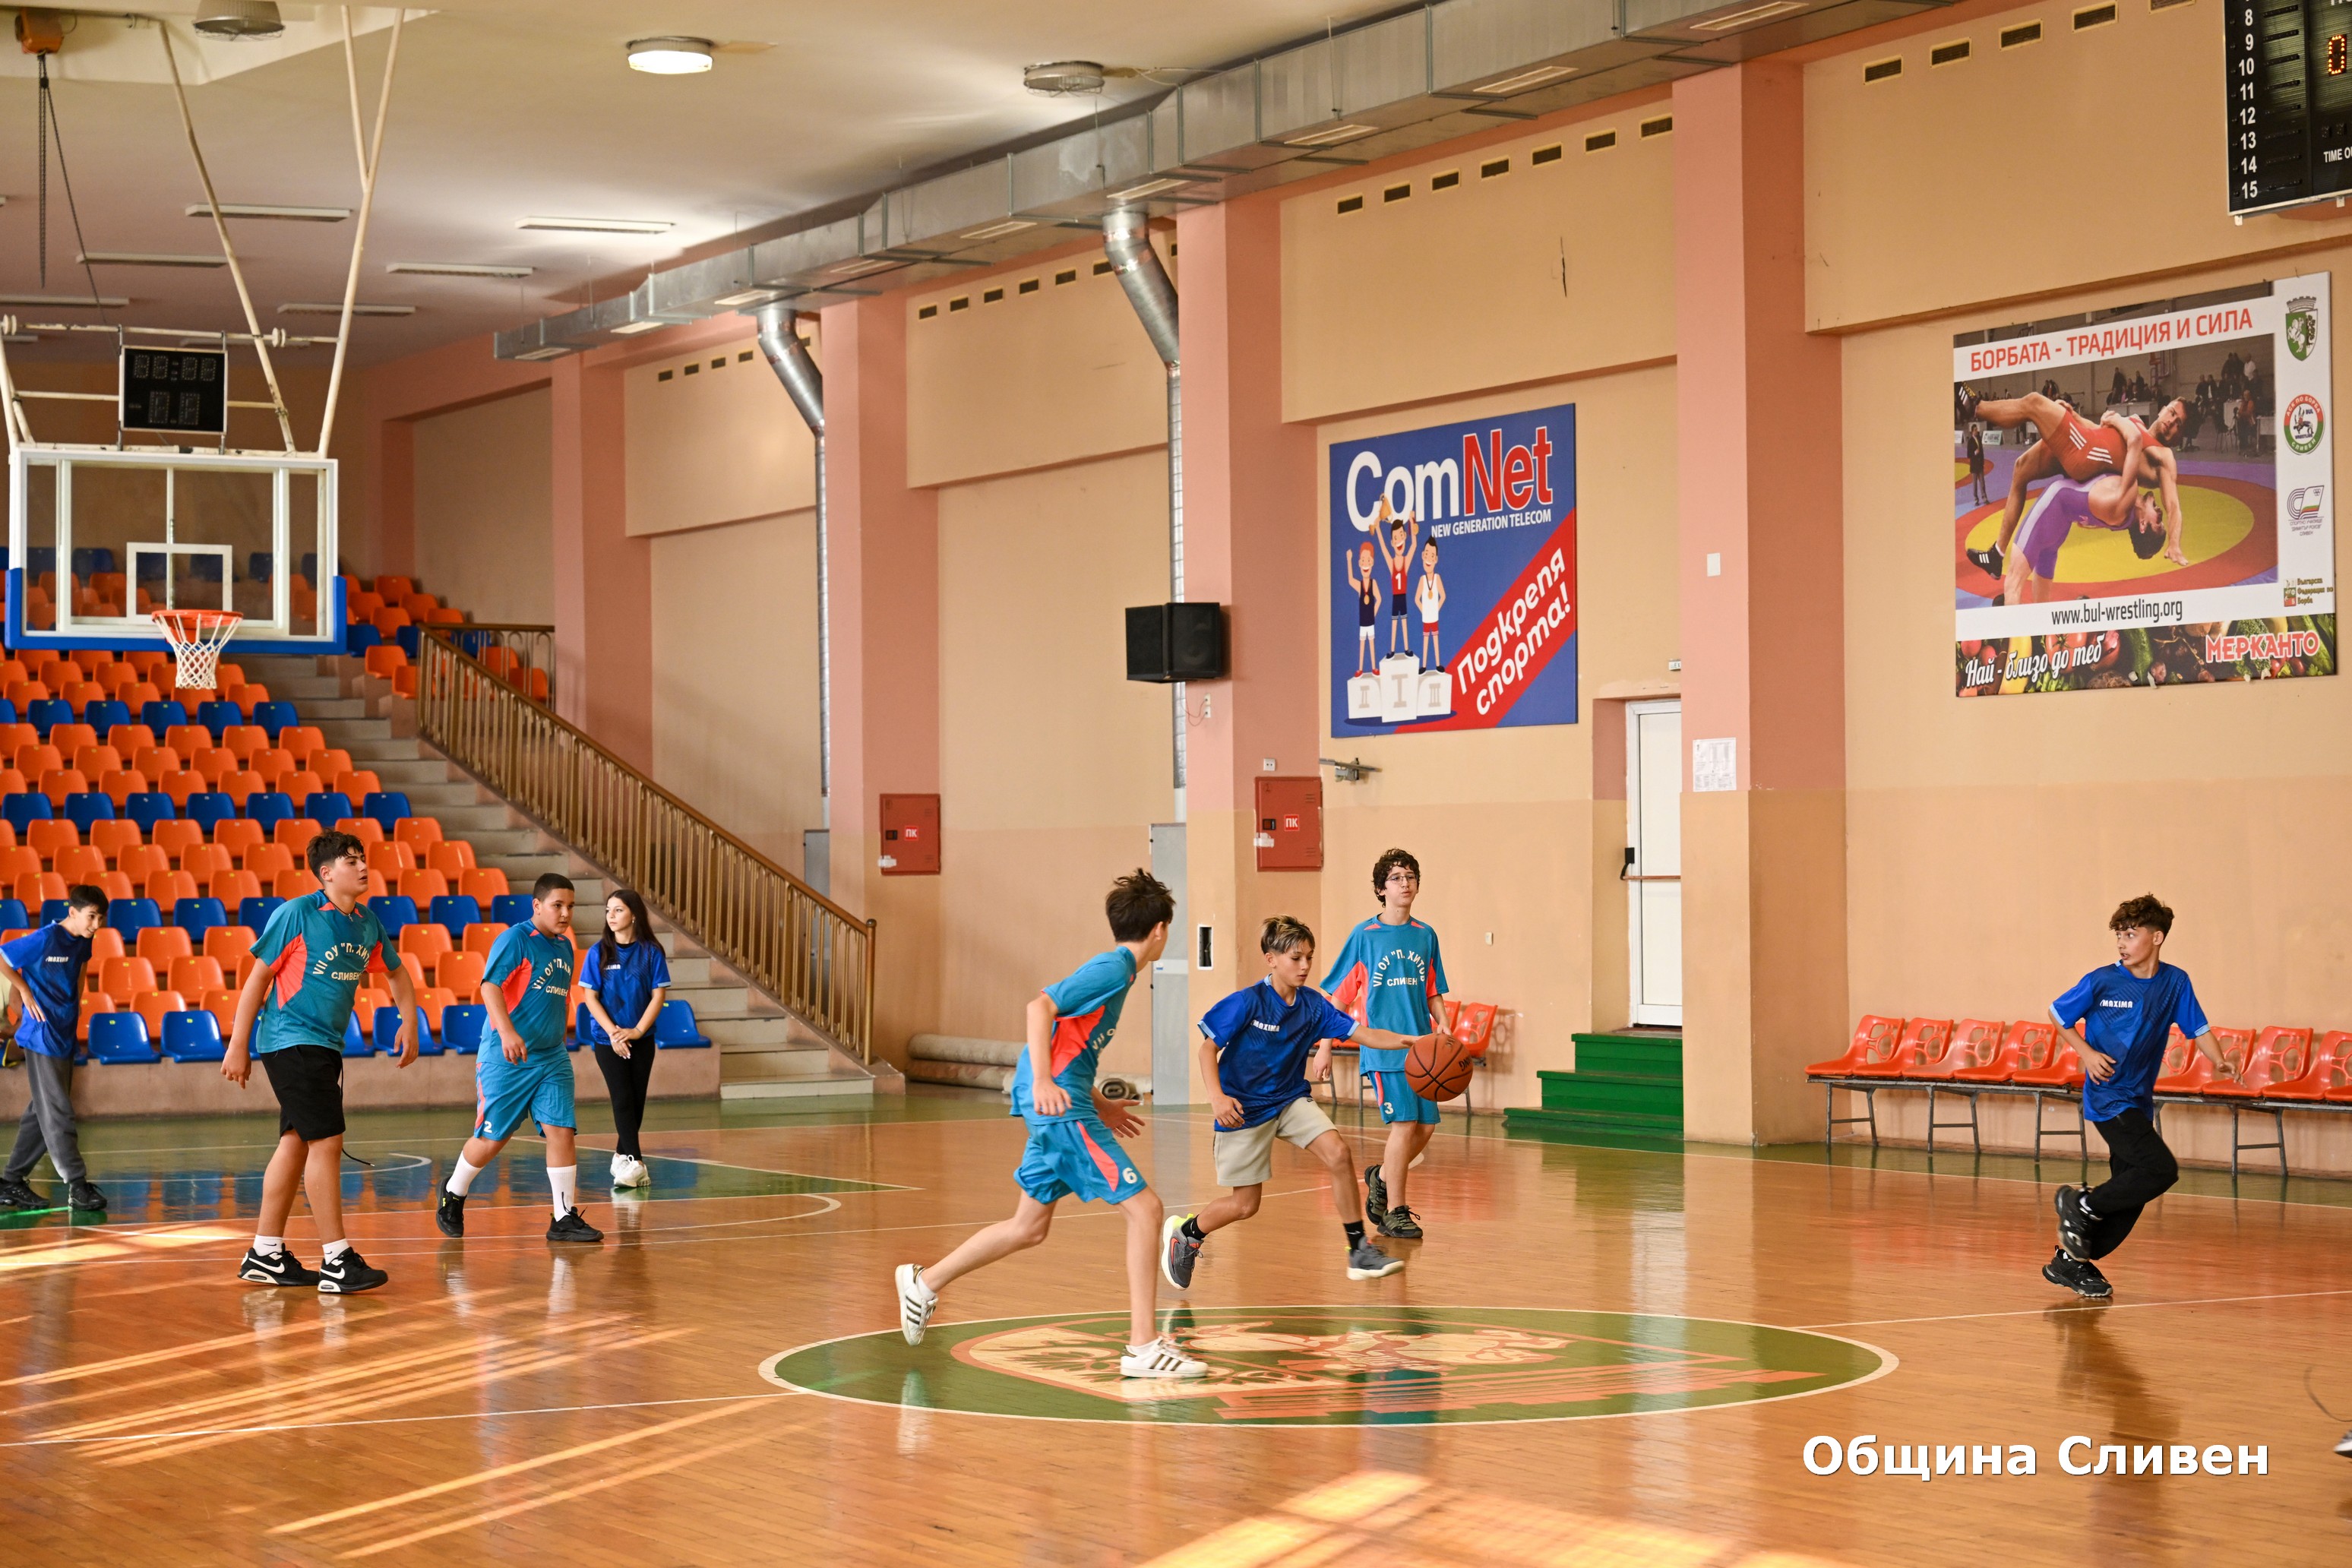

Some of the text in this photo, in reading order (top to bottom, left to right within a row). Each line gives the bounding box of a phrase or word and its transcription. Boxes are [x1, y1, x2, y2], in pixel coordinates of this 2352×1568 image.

[2245, 8, 2253, 27] 8
[2246, 33, 2254, 51] 9
[2328, 34, 2345, 74] 0
[2239, 58, 2255, 76] 10
[2240, 82, 2255, 100] 11
[2240, 106, 2256, 125] 12
[2240, 131, 2256, 150] 13
[2323, 146, 2352, 163] TIME O
[2241, 156, 2257, 175] 14
[2242, 180, 2258, 199] 15
[1971, 341, 2051, 372] БОРБАТА
[2066, 321, 2170, 357] ТРАДИЦИЯ
[2177, 318, 2190, 340] И
[2196, 308, 2253, 337] СИЛА
[1346, 426, 1554, 533] ComNet
[1431, 508, 1551, 538] NEW GENERATION TELECOM
[1395, 572, 1402, 590] 1
[2051, 599, 2183, 624] www.bul-wrestling.org
[1456, 548, 1566, 695] Подкрепя
[1475, 582, 1571, 716] спорта!
[2205, 630, 2320, 663] МЕРКАНТО
[1965, 658, 1996, 687] Най
[2005, 650, 2049, 683] близо
[2051, 650, 2071, 679] до
[2072, 633, 2106, 668] теб
[1285, 818, 1298, 827] ПК
[905, 829, 917, 838] ПК
[312, 959, 328, 975] VII
[324, 945, 339, 961] ОУ
[1377, 956, 1390, 970] ОУ
[532, 976, 545, 989] VII
[545, 962, 553, 976] ОУ
[1373, 972, 1383, 987] VII
[2100, 999, 2133, 1008] MAXIMA
[1384, 1102, 1394, 1114] 3
[484, 1121, 492, 1133] 2
[1122, 1167, 1138, 1184] 6
